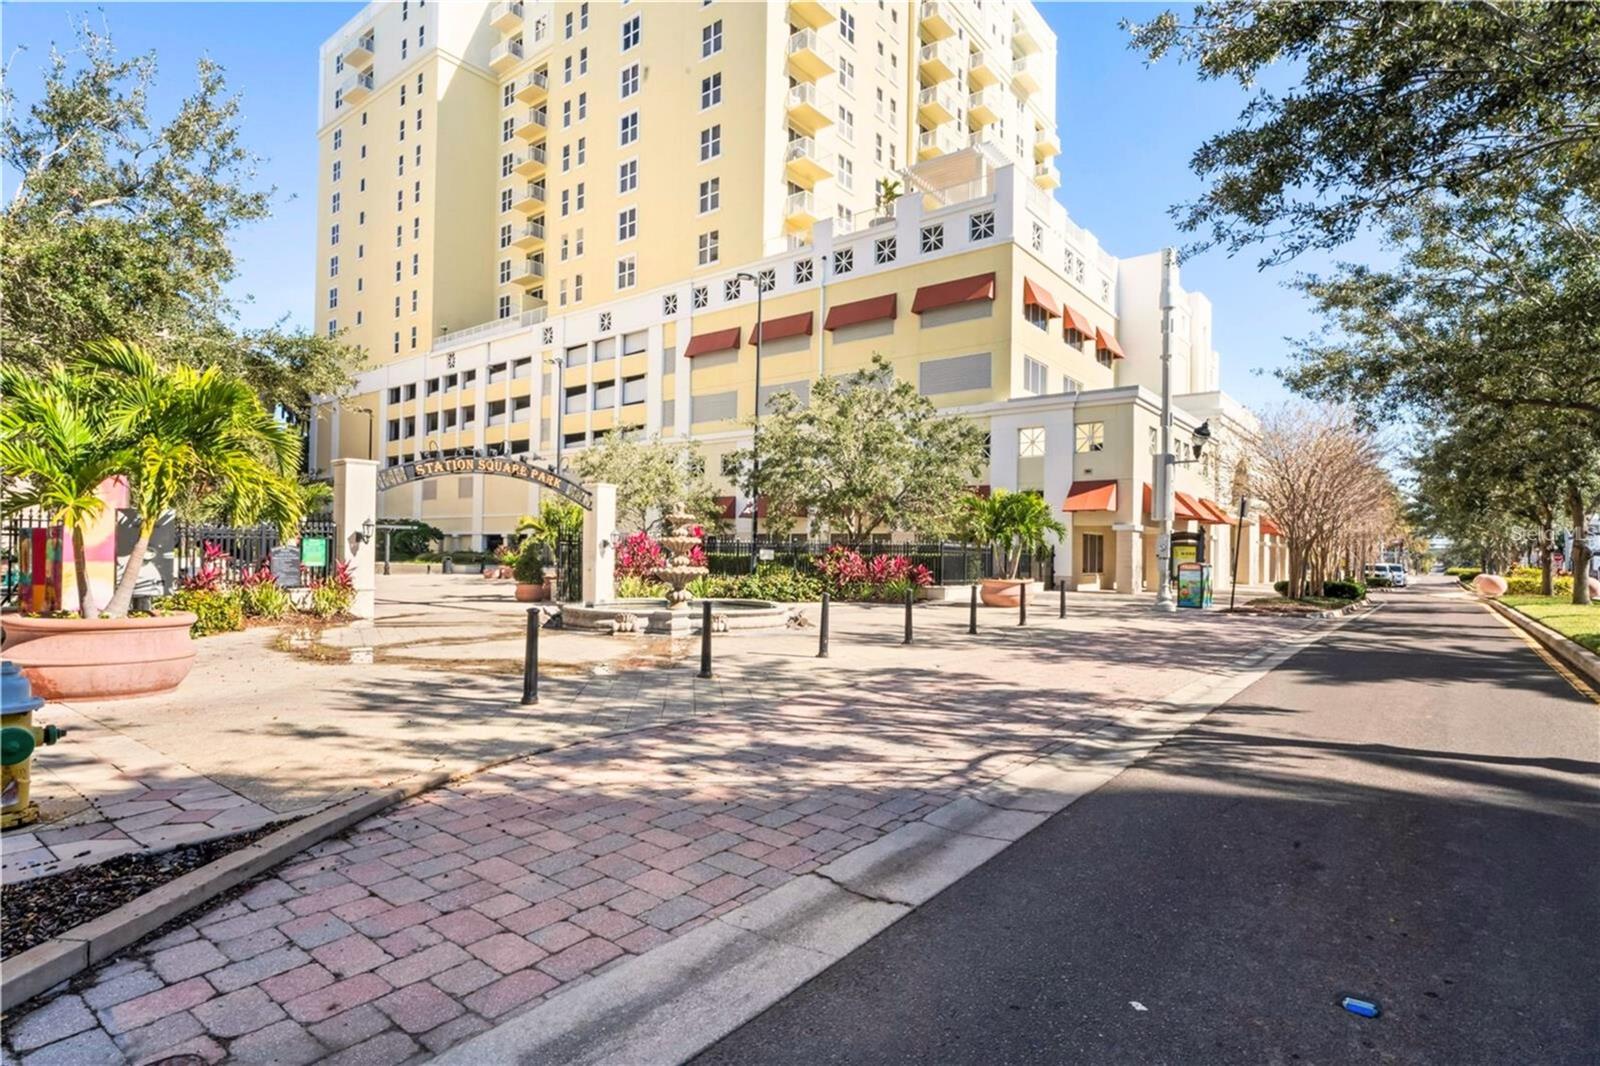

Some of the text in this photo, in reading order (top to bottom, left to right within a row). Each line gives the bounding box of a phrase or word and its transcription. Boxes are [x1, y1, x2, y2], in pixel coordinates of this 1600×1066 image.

[415, 459, 562, 489] STATION SQUARE PARK
